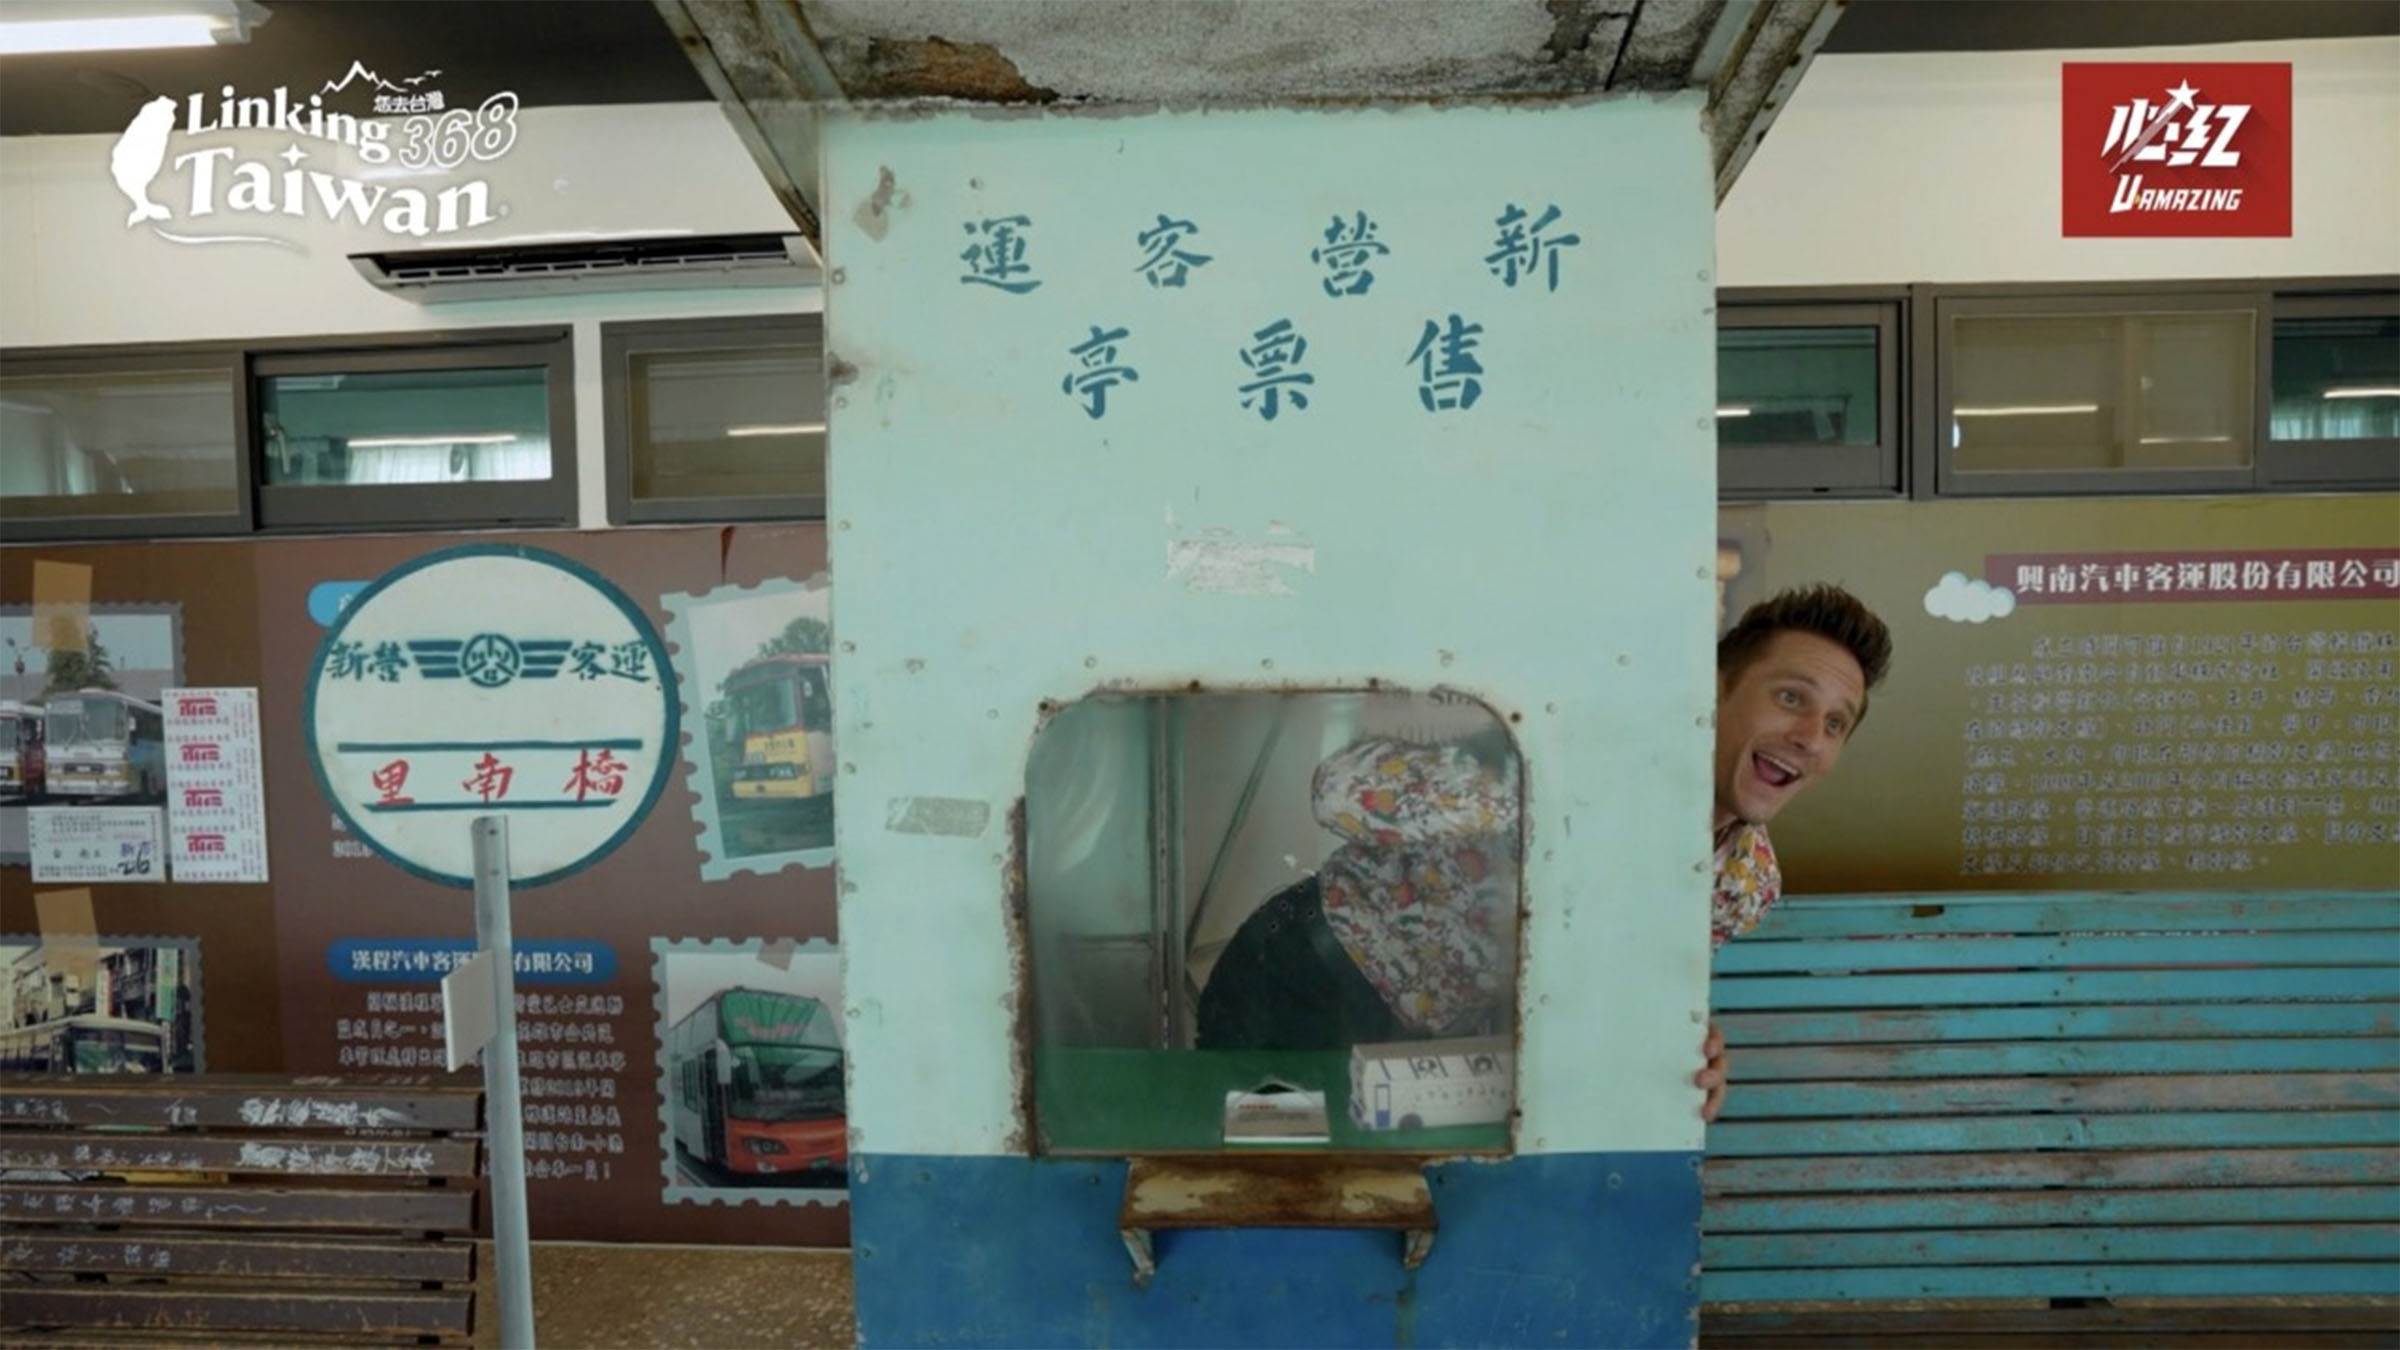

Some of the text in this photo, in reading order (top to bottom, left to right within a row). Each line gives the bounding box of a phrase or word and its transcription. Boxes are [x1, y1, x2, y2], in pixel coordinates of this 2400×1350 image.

[2016, 559, 2400, 593] 興南汽車客運股份有限公司
[352, 949, 593, 974] 漢程汽車客運有限公司
